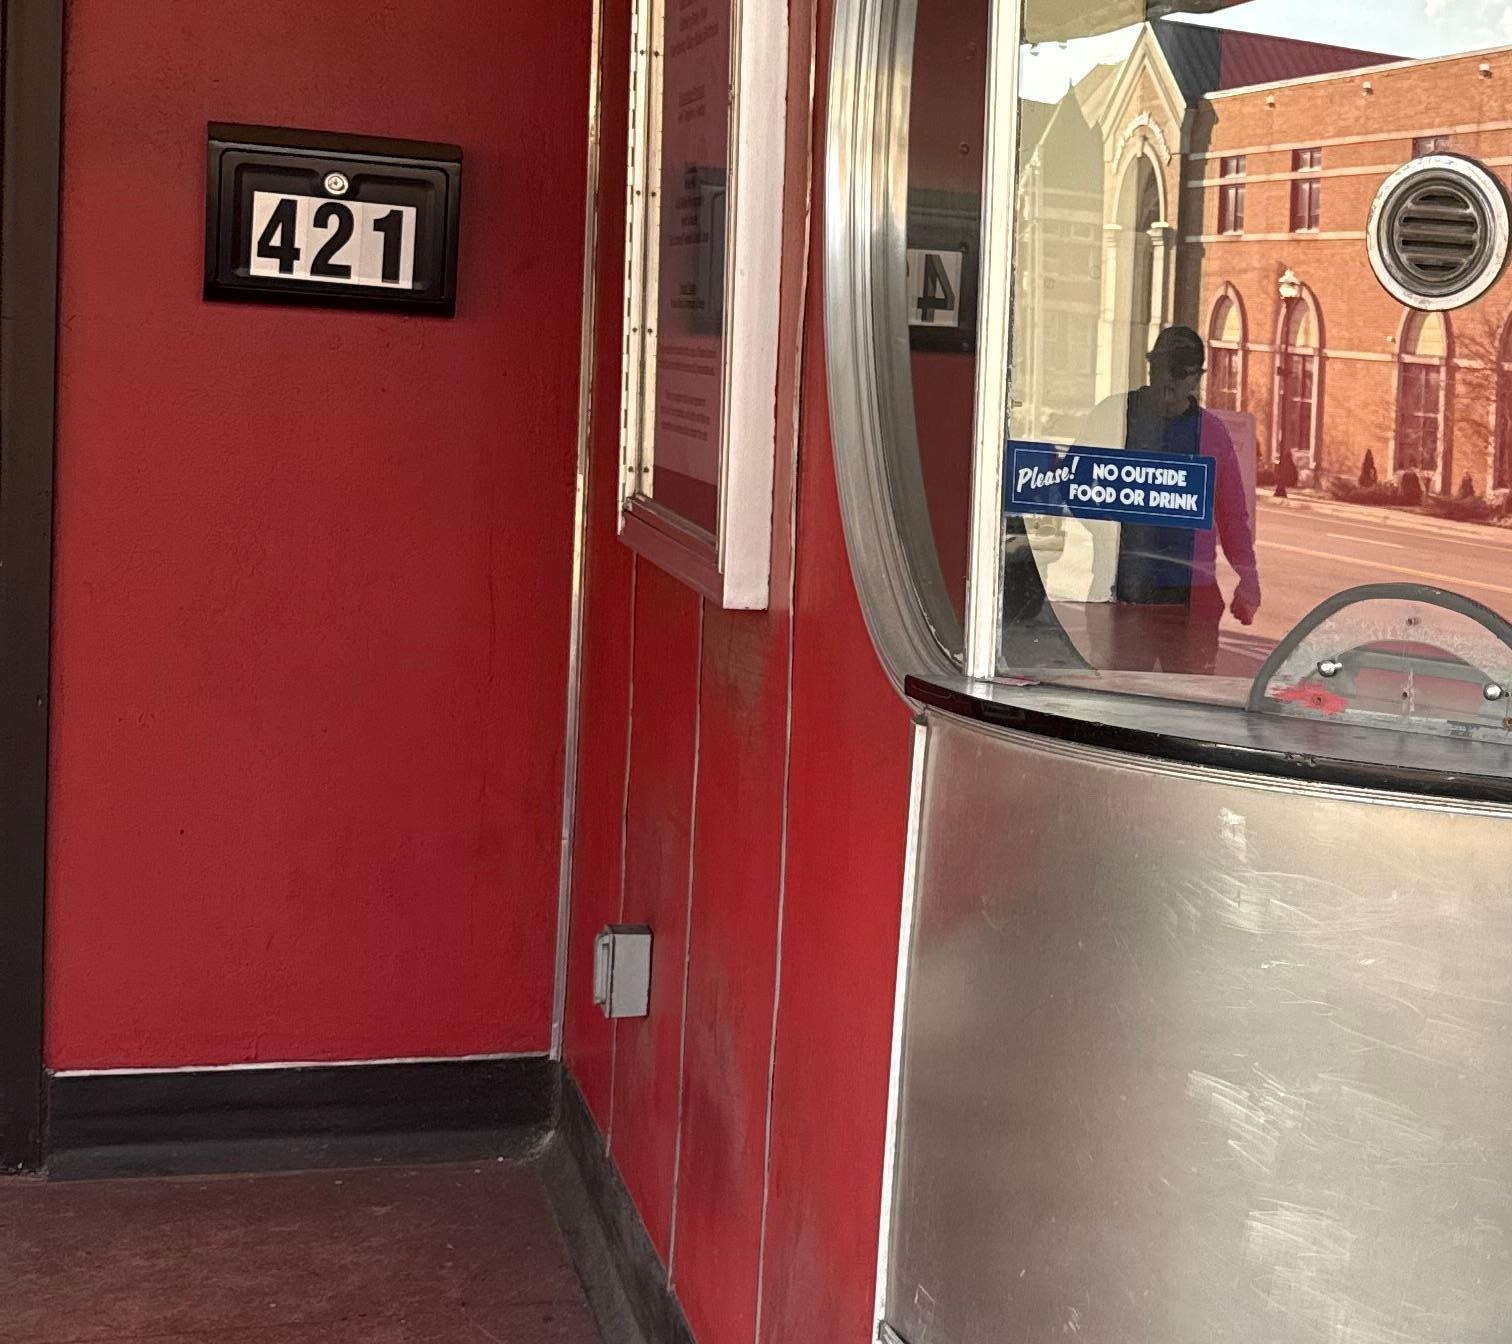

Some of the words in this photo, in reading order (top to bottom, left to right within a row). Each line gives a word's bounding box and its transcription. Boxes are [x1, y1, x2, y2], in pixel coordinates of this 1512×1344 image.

[256, 198, 404, 284] 421
[1016, 456, 1081, 493] Please!
[1092, 462, 1119, 481] NO
[1120, 465, 1188, 487] OUTSIDE
[1069, 483, 1117, 504] FOOD
[1119, 487, 1145, 506] OR
[1148, 490, 1199, 512] DRINK
